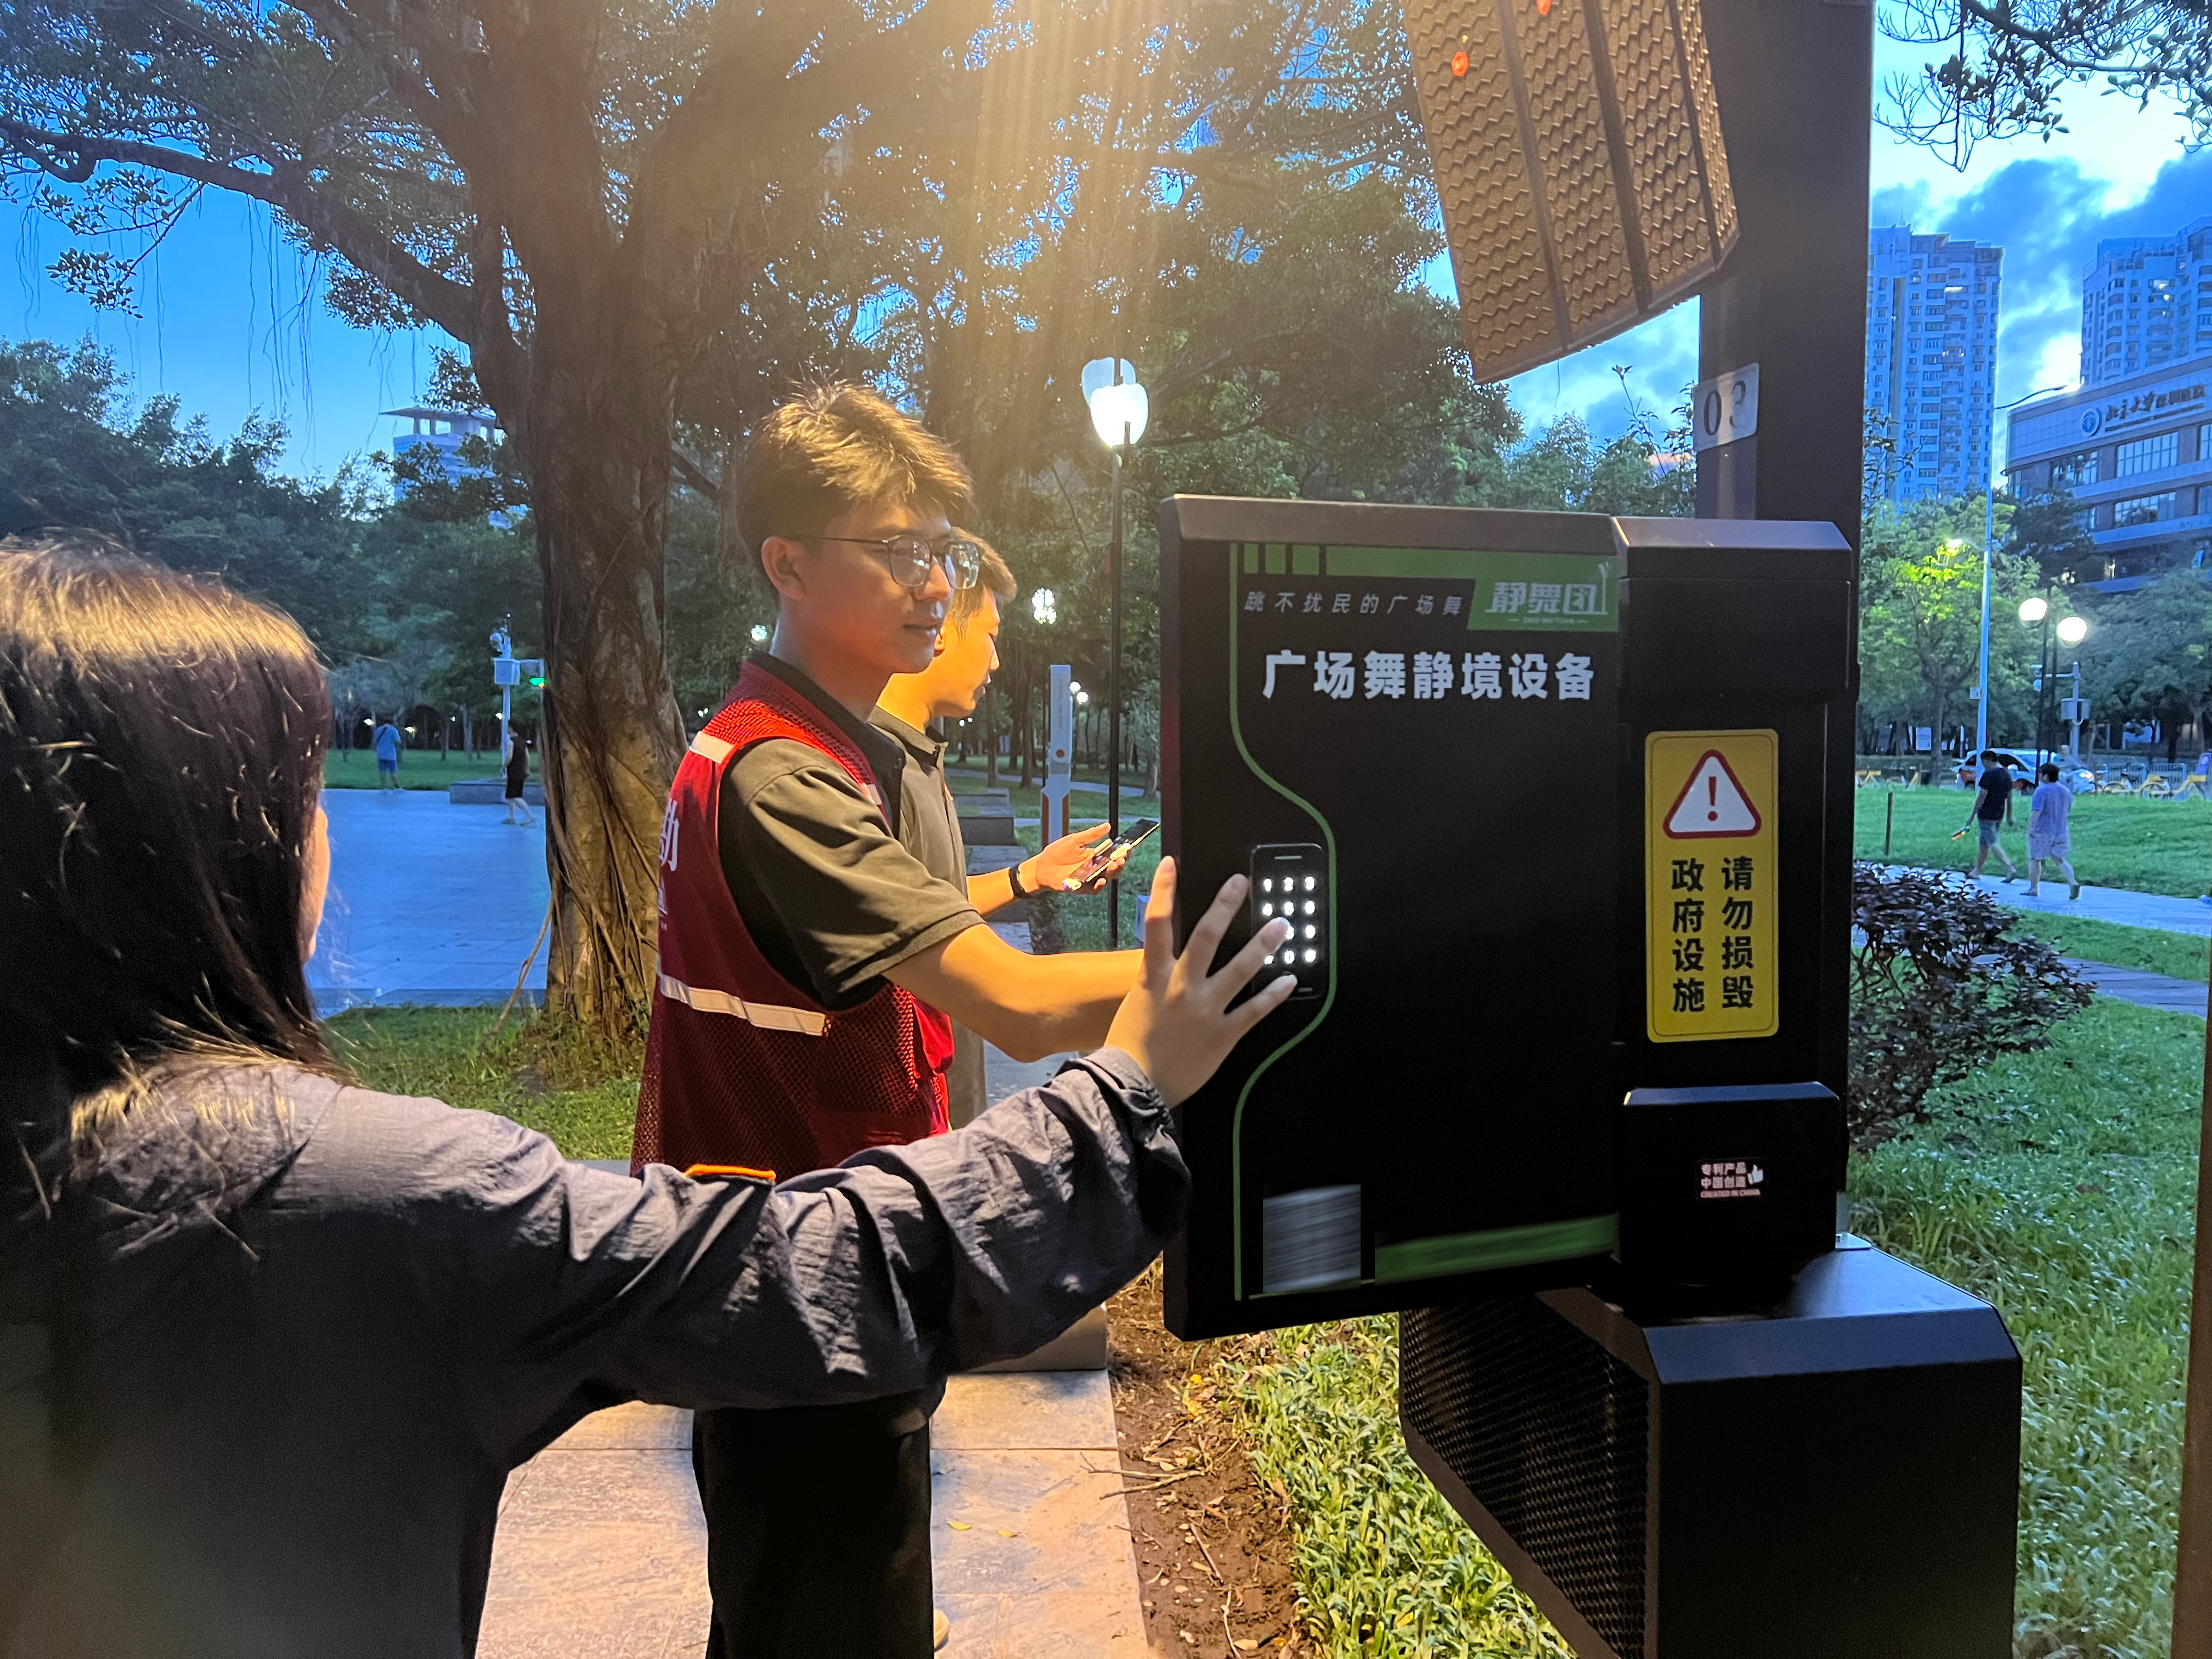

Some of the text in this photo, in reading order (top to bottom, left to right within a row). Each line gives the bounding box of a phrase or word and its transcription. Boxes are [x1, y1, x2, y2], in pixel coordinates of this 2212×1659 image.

[1703, 381, 1747, 436] 03
[1244, 591, 1463, 616] 跳不扰民的广场舞
[1263, 650, 1595, 701] 广场舞静境设备
[1672, 857, 1705, 1013] 政府设施
[1722, 856, 1754, 1009] 请勿损毁
